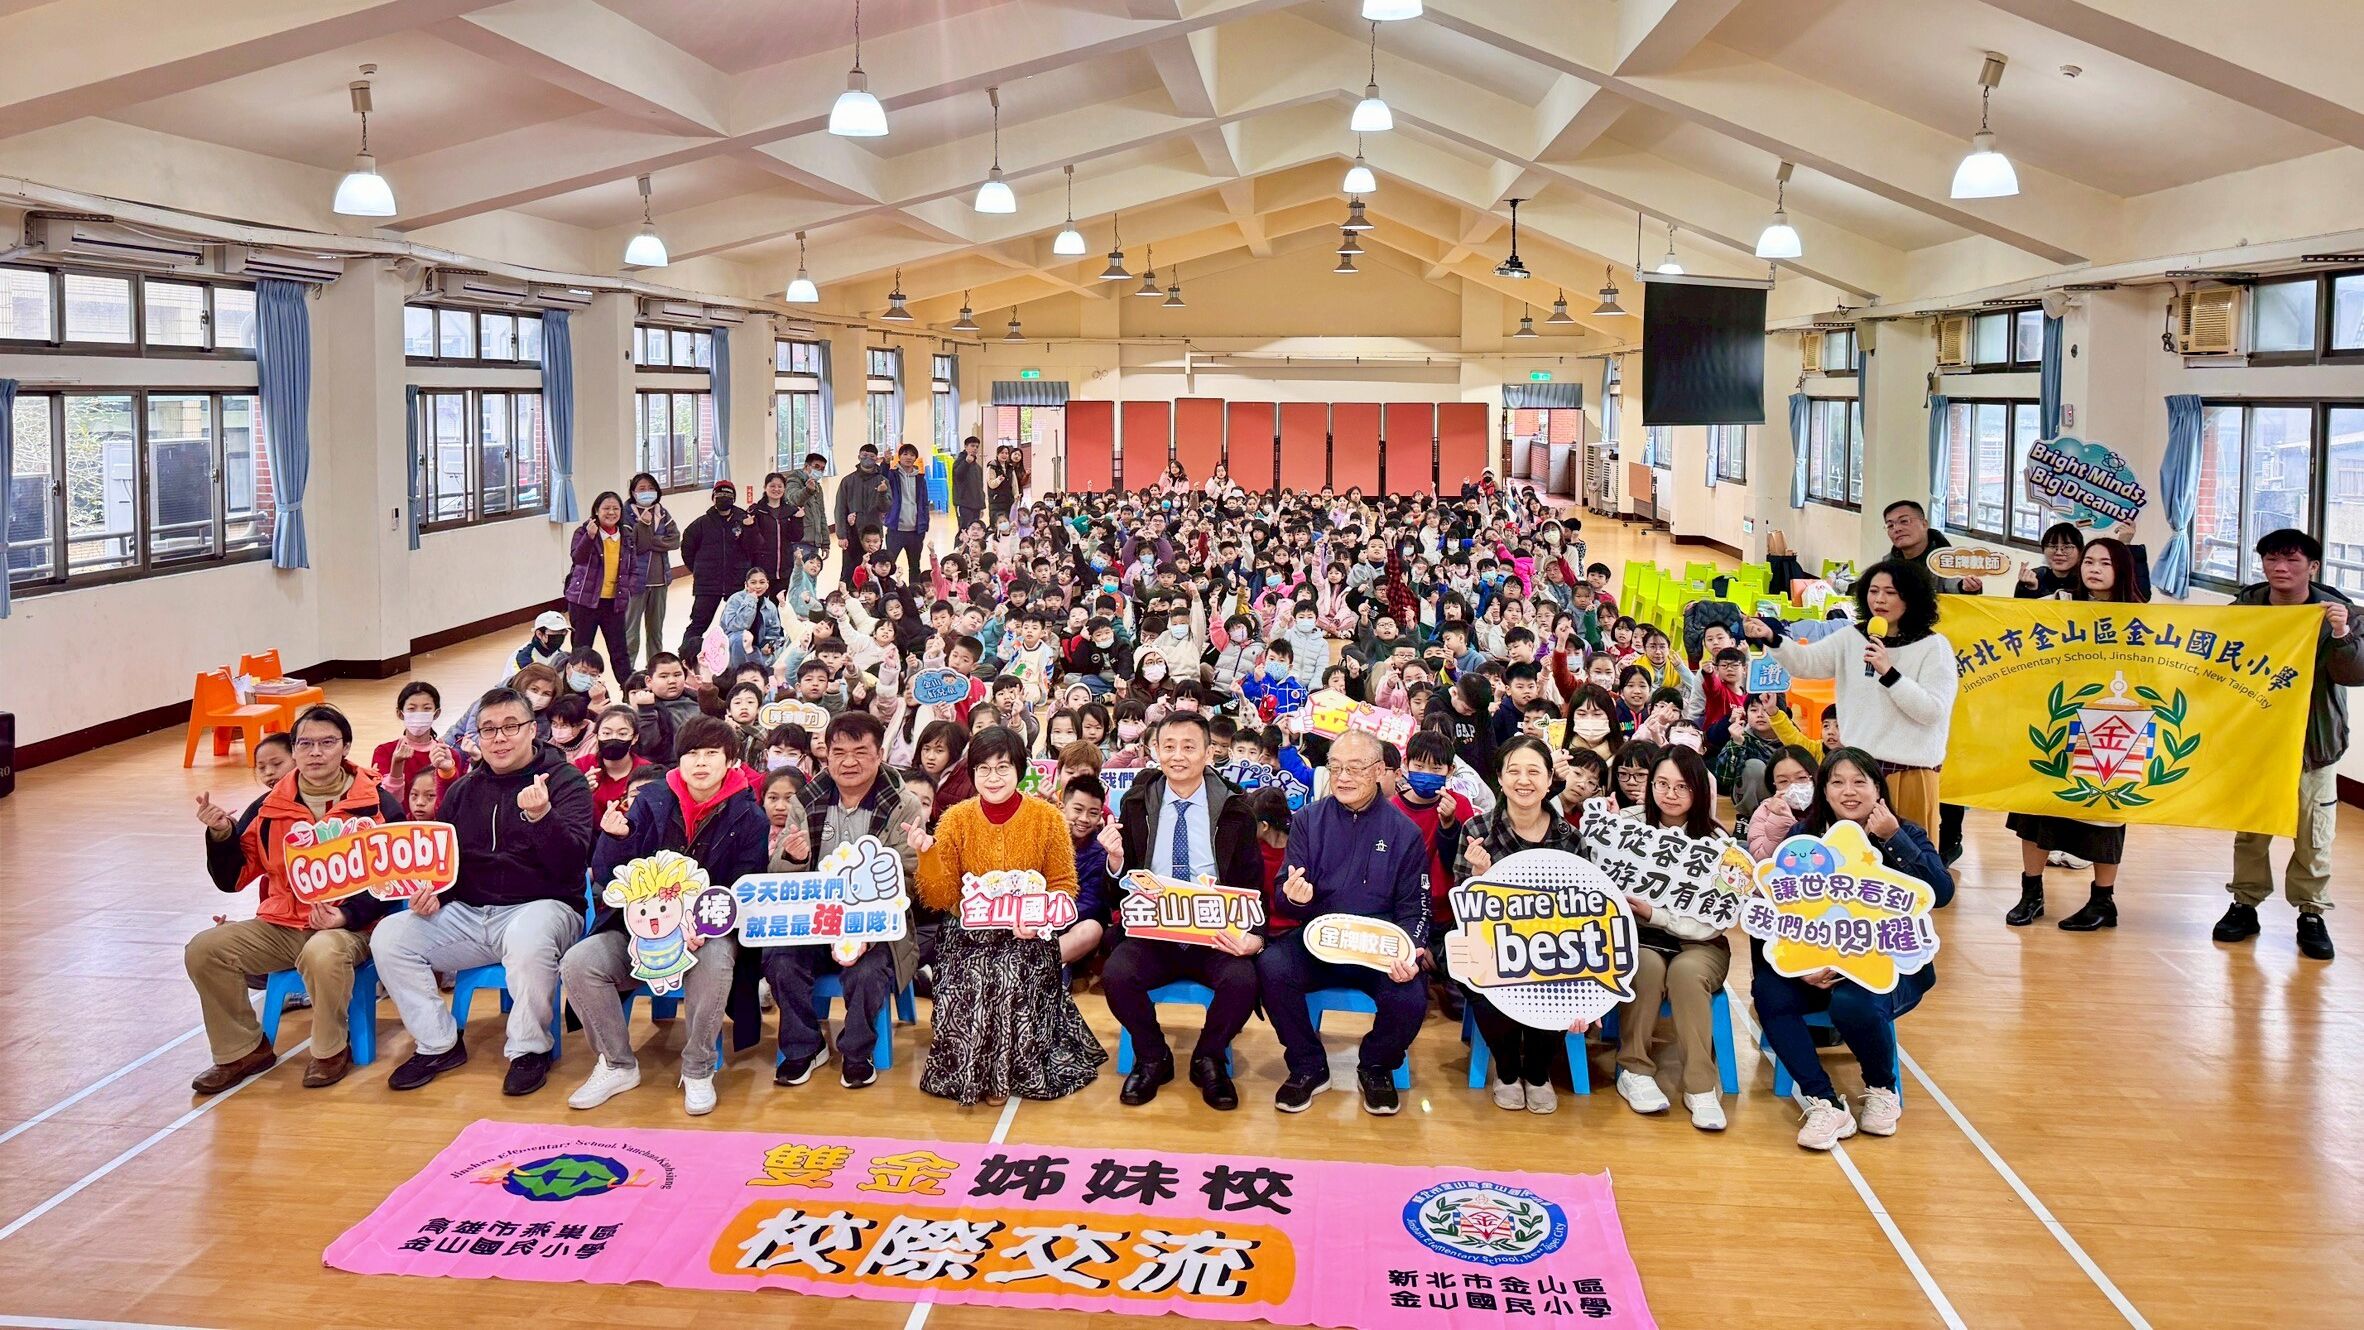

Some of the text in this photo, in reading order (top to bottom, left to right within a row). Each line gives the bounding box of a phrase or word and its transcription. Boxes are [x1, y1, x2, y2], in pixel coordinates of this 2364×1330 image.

[2029, 441, 2148, 508] Bright Minds,
[2030, 466, 2140, 525] Big Dreams!
[1963, 650, 2273, 710] Jinshan Elementary School, Jinshan District, New Taipei City
[1455, 722, 1477, 738] GAP
[2088, 713, 2139, 752] 金
[1583, 802, 1719, 879] 從從容容
[291, 829, 449, 895] Good Job!
[1455, 891, 1503, 921] We
[1506, 893, 1555, 919] are
[1557, 887, 1607, 917] the
[1600, 856, 1740, 924] 游刃有餘
[1771, 874, 1915, 912] 讓世界看到
[698, 893, 732, 928] 棒
[745, 903, 898, 938] 就是最強團隊！
[962, 893, 1075, 927] 金山國小
[1121, 893, 1264, 930] 金山國小
[1747, 904, 1933, 952] 我們的閃耀！
[450, 1158, 495, 1179] Jinshan
[498, 1143, 570, 1160] Elementary
[397, 1235, 608, 1260] 金山國民小學
[417, 1217, 624, 1241] 高雄市燕巢區
[1424, 1238, 1480, 1262] Elementary
[1482, 1254, 1524, 1265] School,
[1553, 1222, 1567, 1237] City
[737, 1207, 1262, 1297] 校際交流
[1388, 1269, 1607, 1295] 新北市金山區
[1389, 1291, 1612, 1319] 金山國民小學
